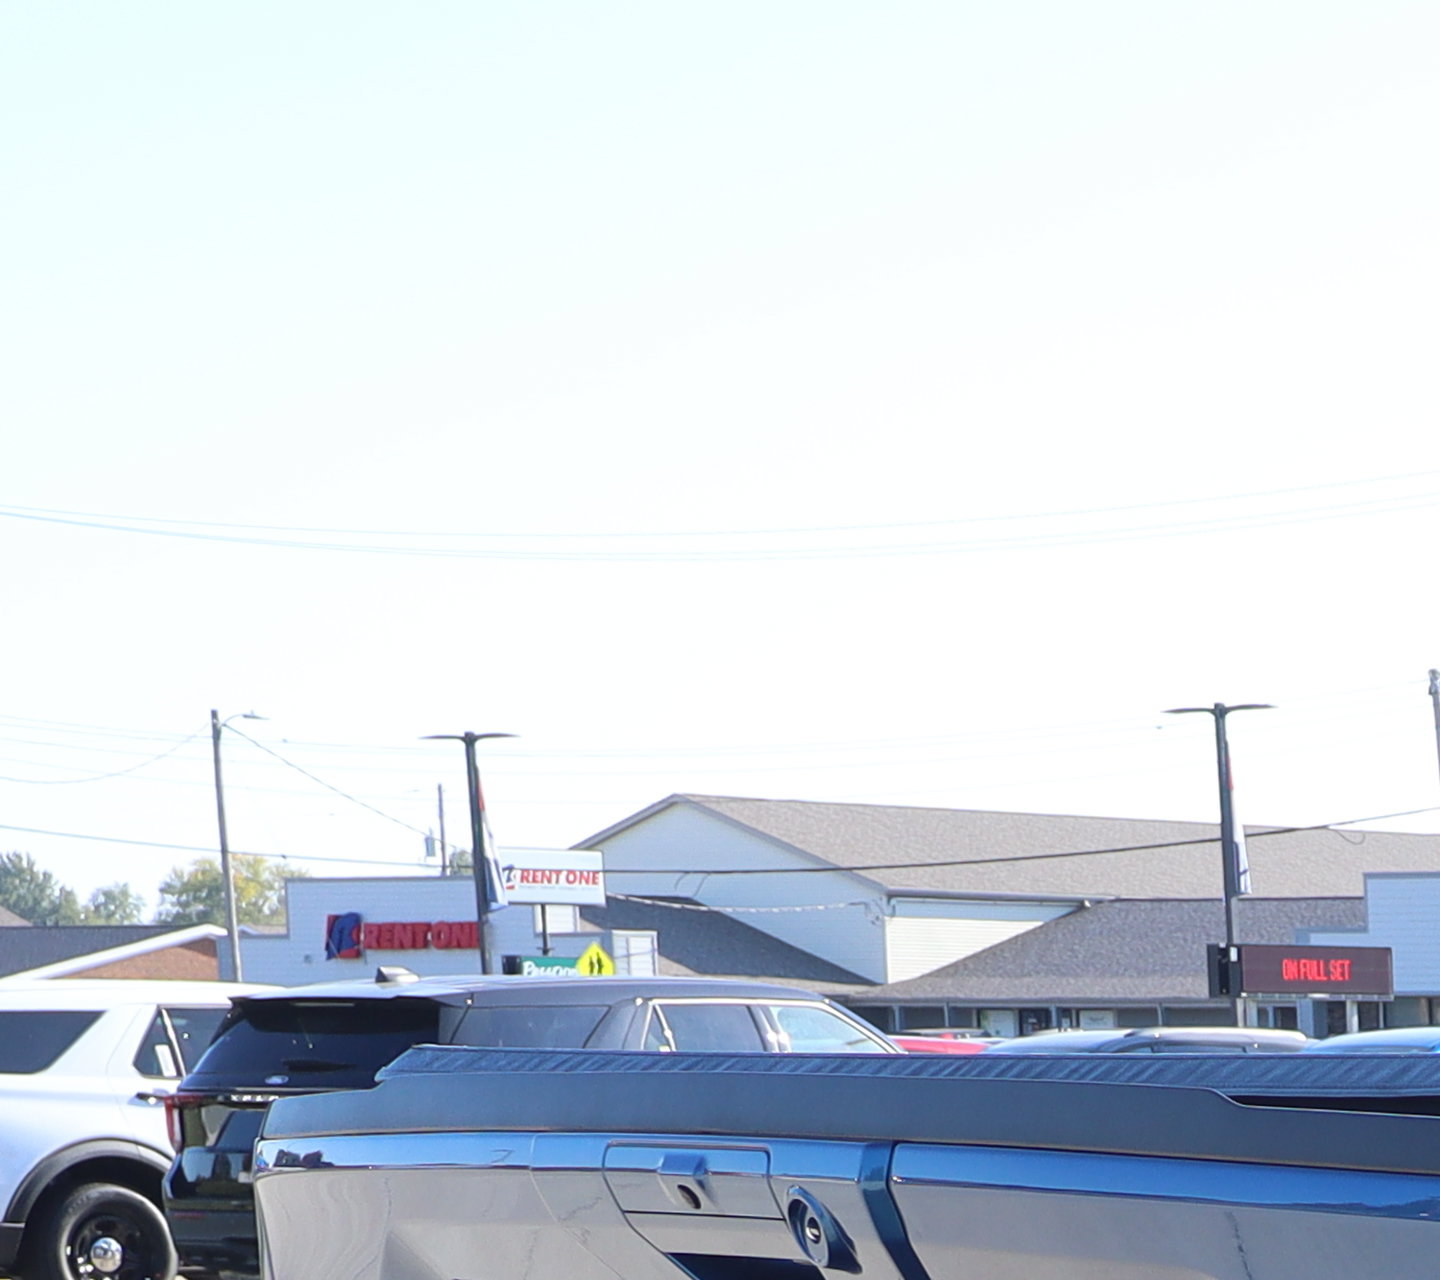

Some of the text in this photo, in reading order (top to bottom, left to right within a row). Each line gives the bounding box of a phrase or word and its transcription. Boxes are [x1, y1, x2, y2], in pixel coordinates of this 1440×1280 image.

[520, 869, 600, 886] RENT ONE
[364, 922, 430, 950] RENT
[1300, 959, 1327, 981] FULL
[1330, 959, 1351, 981] SET
